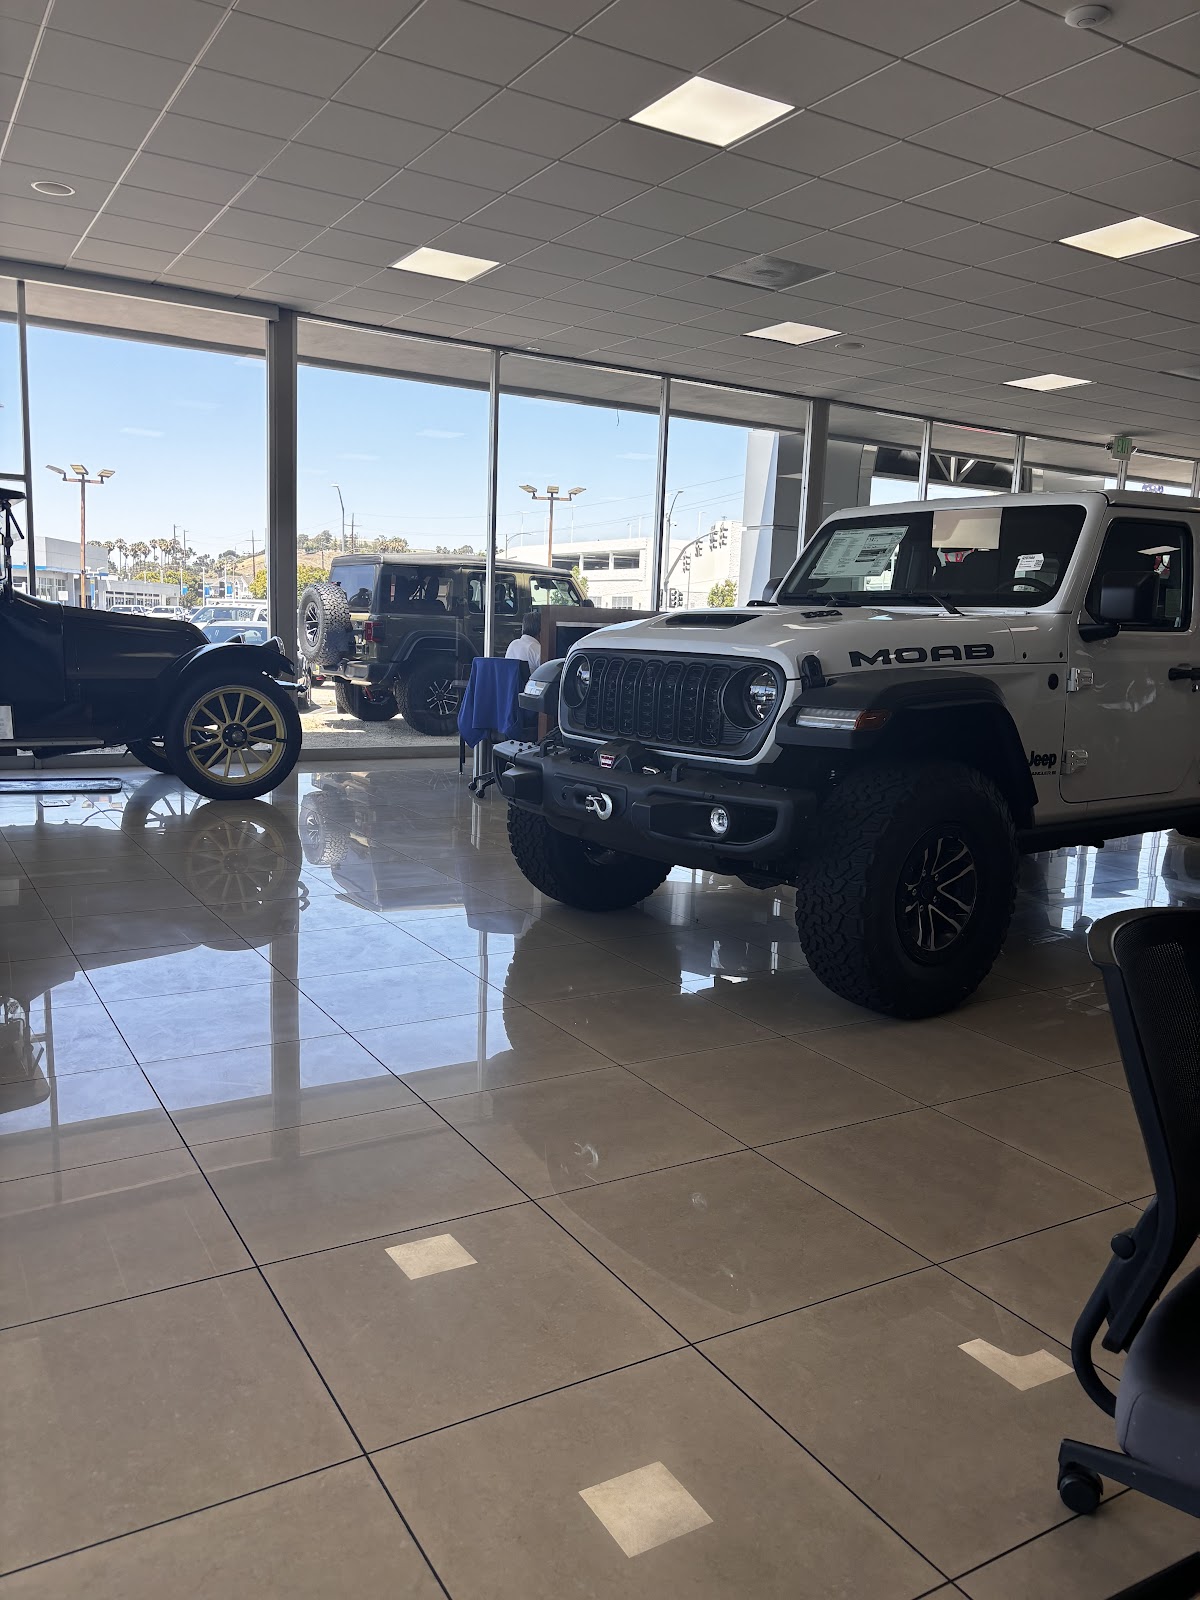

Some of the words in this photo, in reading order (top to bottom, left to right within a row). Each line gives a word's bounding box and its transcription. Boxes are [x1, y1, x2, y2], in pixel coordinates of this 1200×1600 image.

[1117, 438, 1130, 454] EXIT
[848, 643, 995, 668] MOAB
[1028, 750, 1057, 769] Jeep
